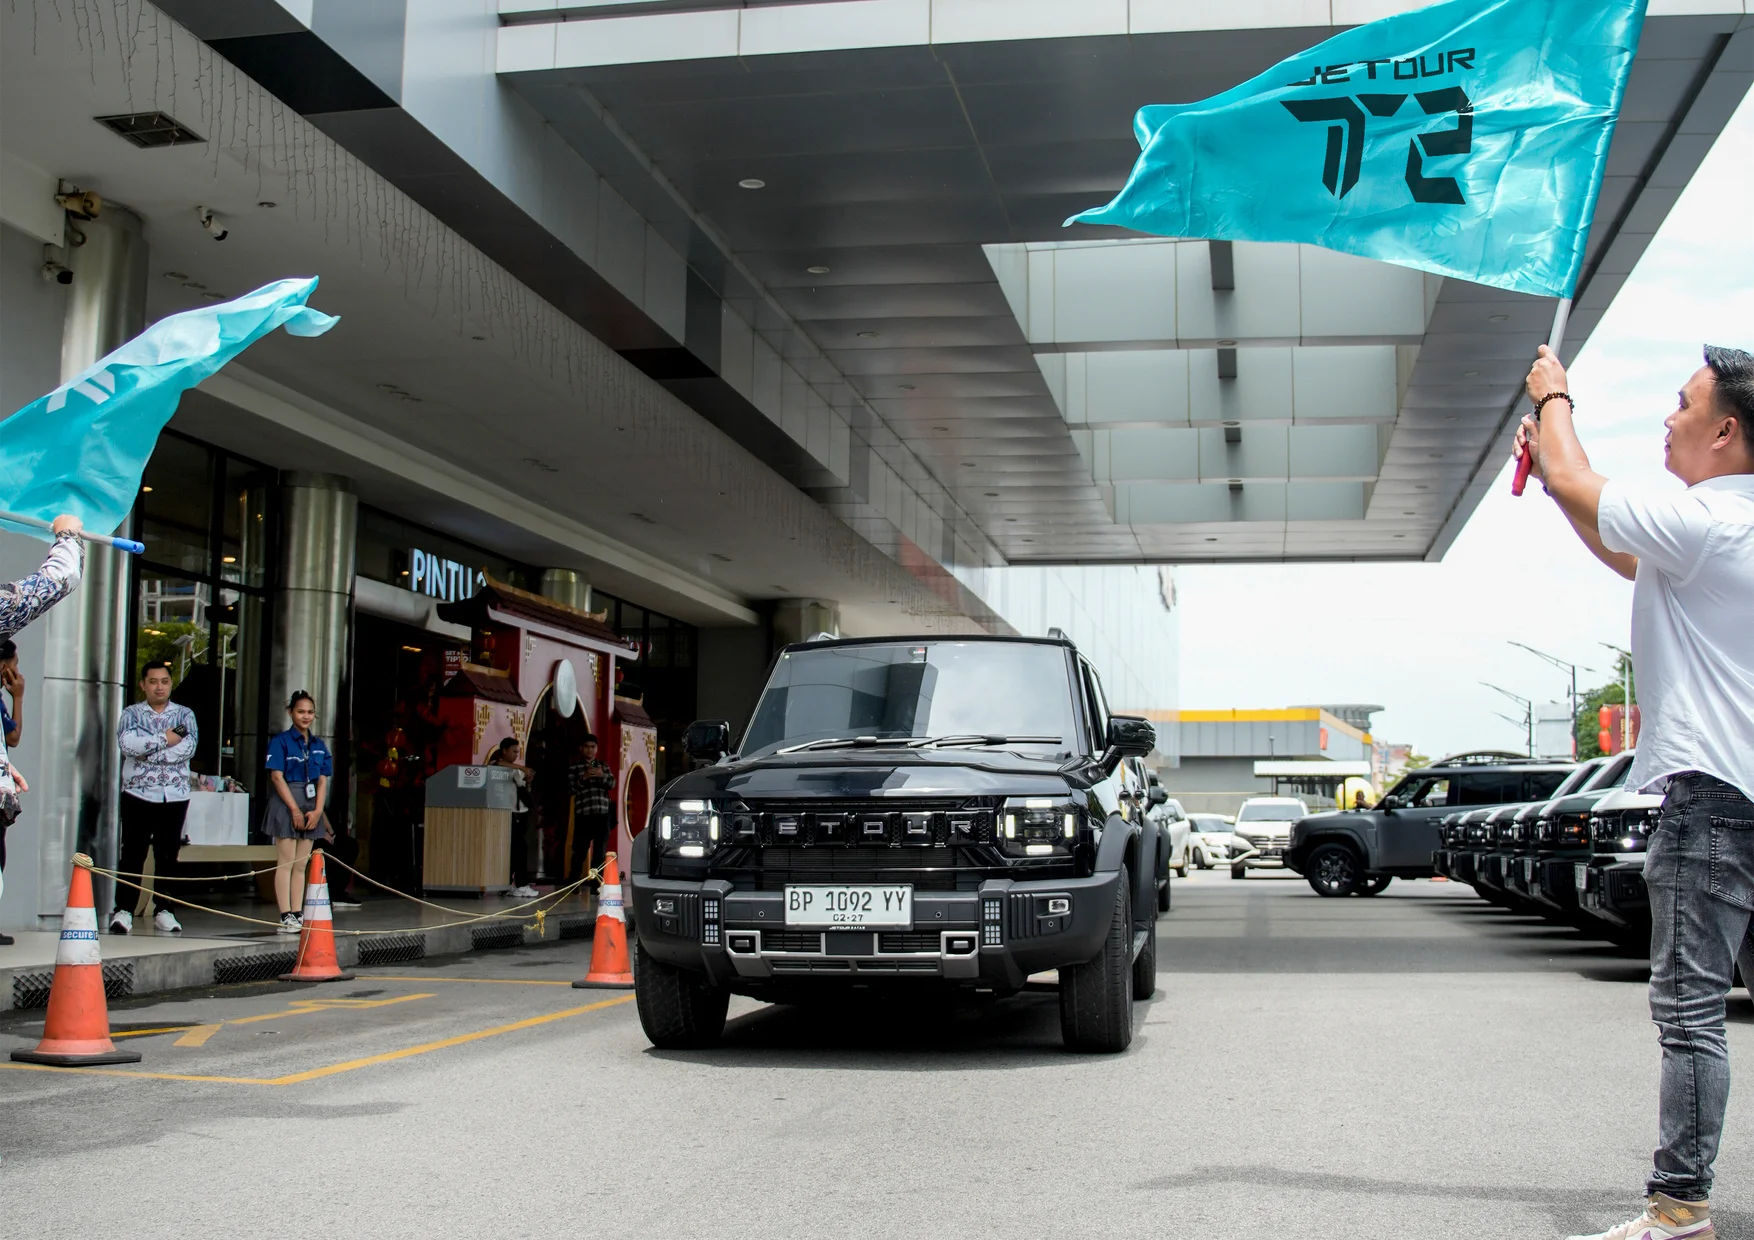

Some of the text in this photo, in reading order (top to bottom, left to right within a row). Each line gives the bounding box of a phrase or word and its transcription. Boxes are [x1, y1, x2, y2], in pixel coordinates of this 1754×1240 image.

[1287, 48, 1475, 86] JETOUR
[411, 548, 472, 603] PINTU
[739, 820, 971, 835] JETOUR
[789, 891, 906, 911] BP 1092 YY
[63, 931, 93, 939] secure
